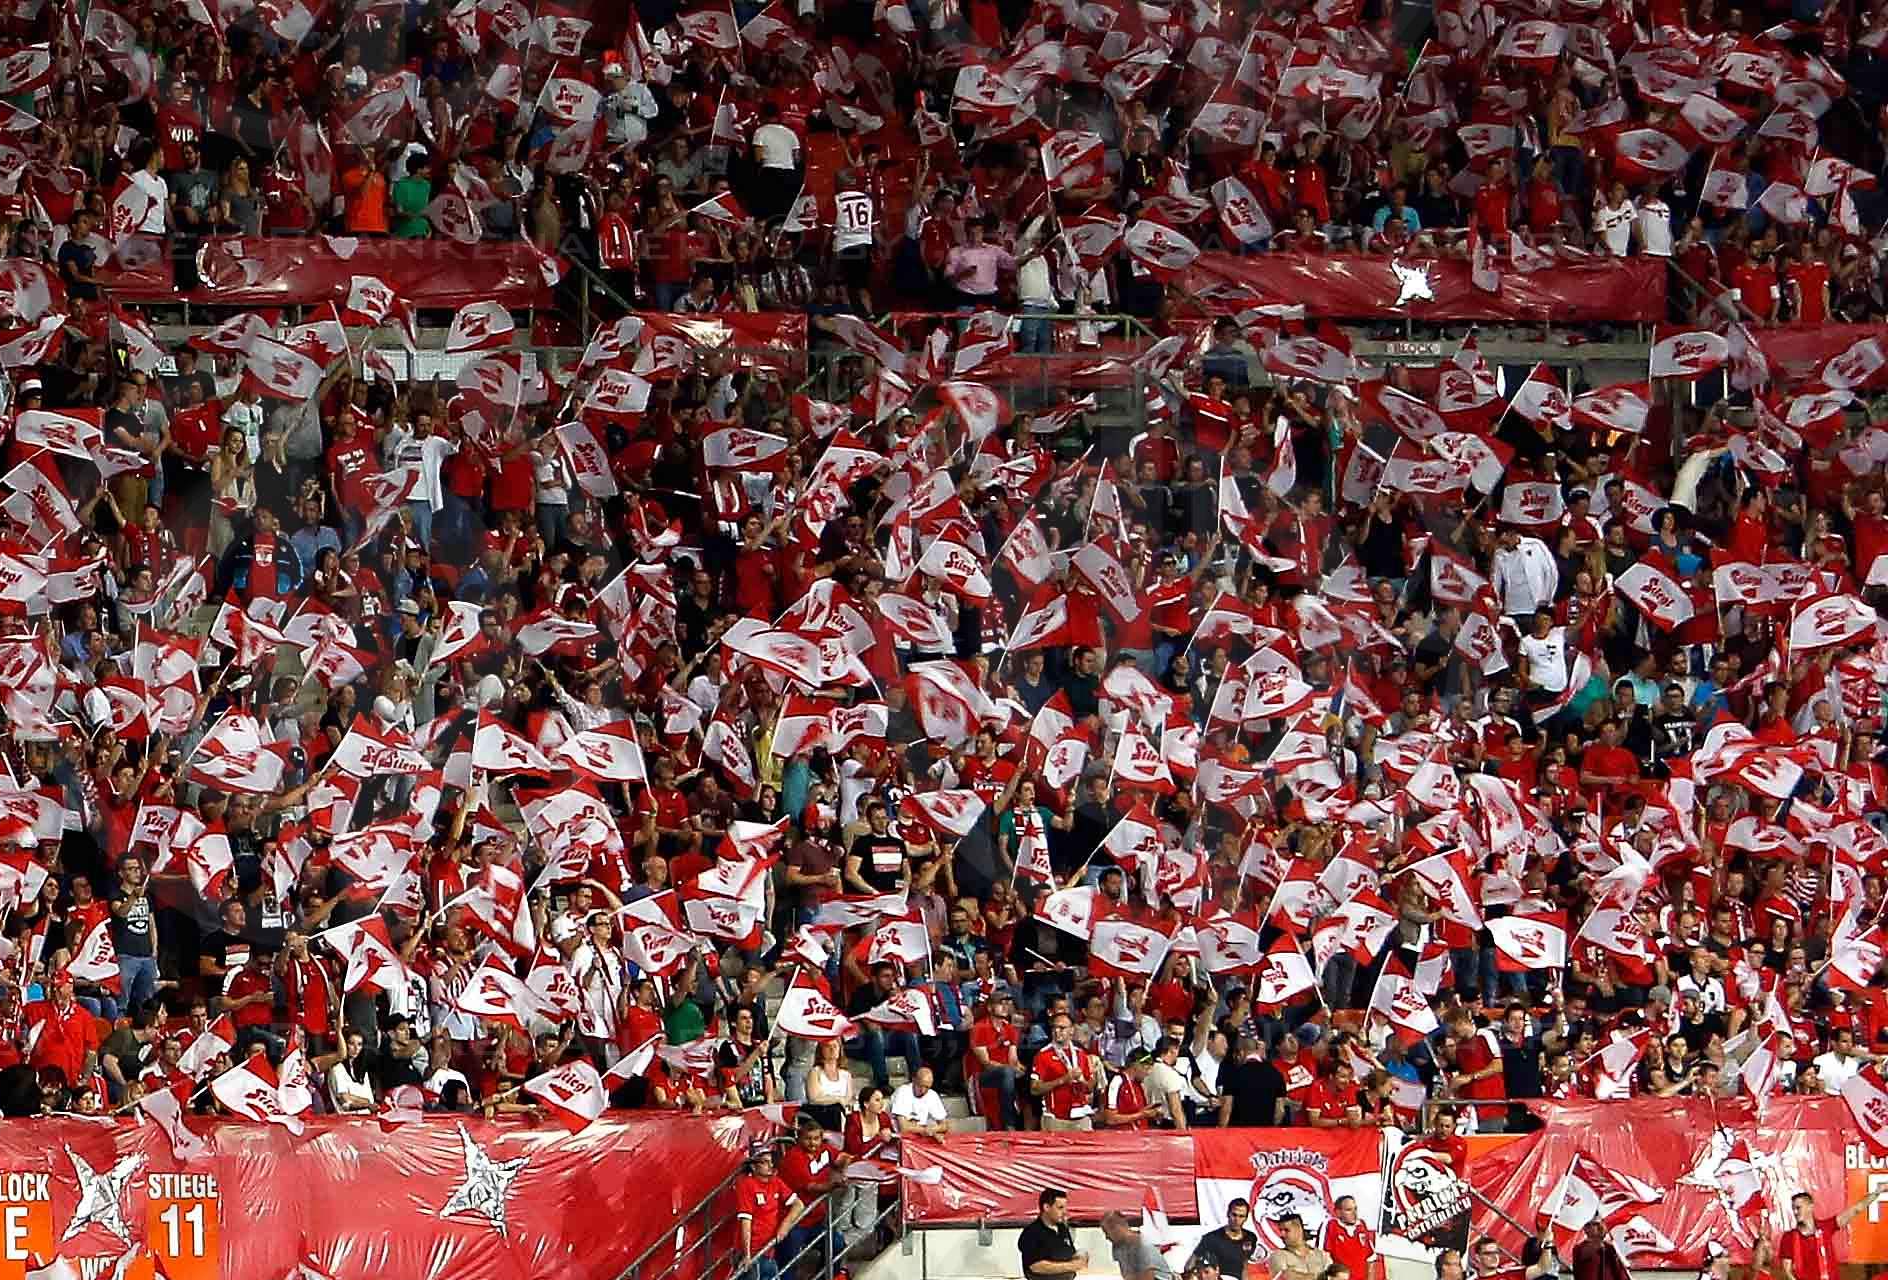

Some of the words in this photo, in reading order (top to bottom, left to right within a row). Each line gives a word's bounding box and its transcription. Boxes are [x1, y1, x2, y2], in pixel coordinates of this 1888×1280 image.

[844, 203, 868, 228] 16
[947, 551, 977, 576] Stiegl
[1642, 578, 1675, 607] Stiegl
[146, 1171, 218, 1201] STIEGE
[5, 1206, 29, 1261] E
[159, 1205, 207, 1257] 11
